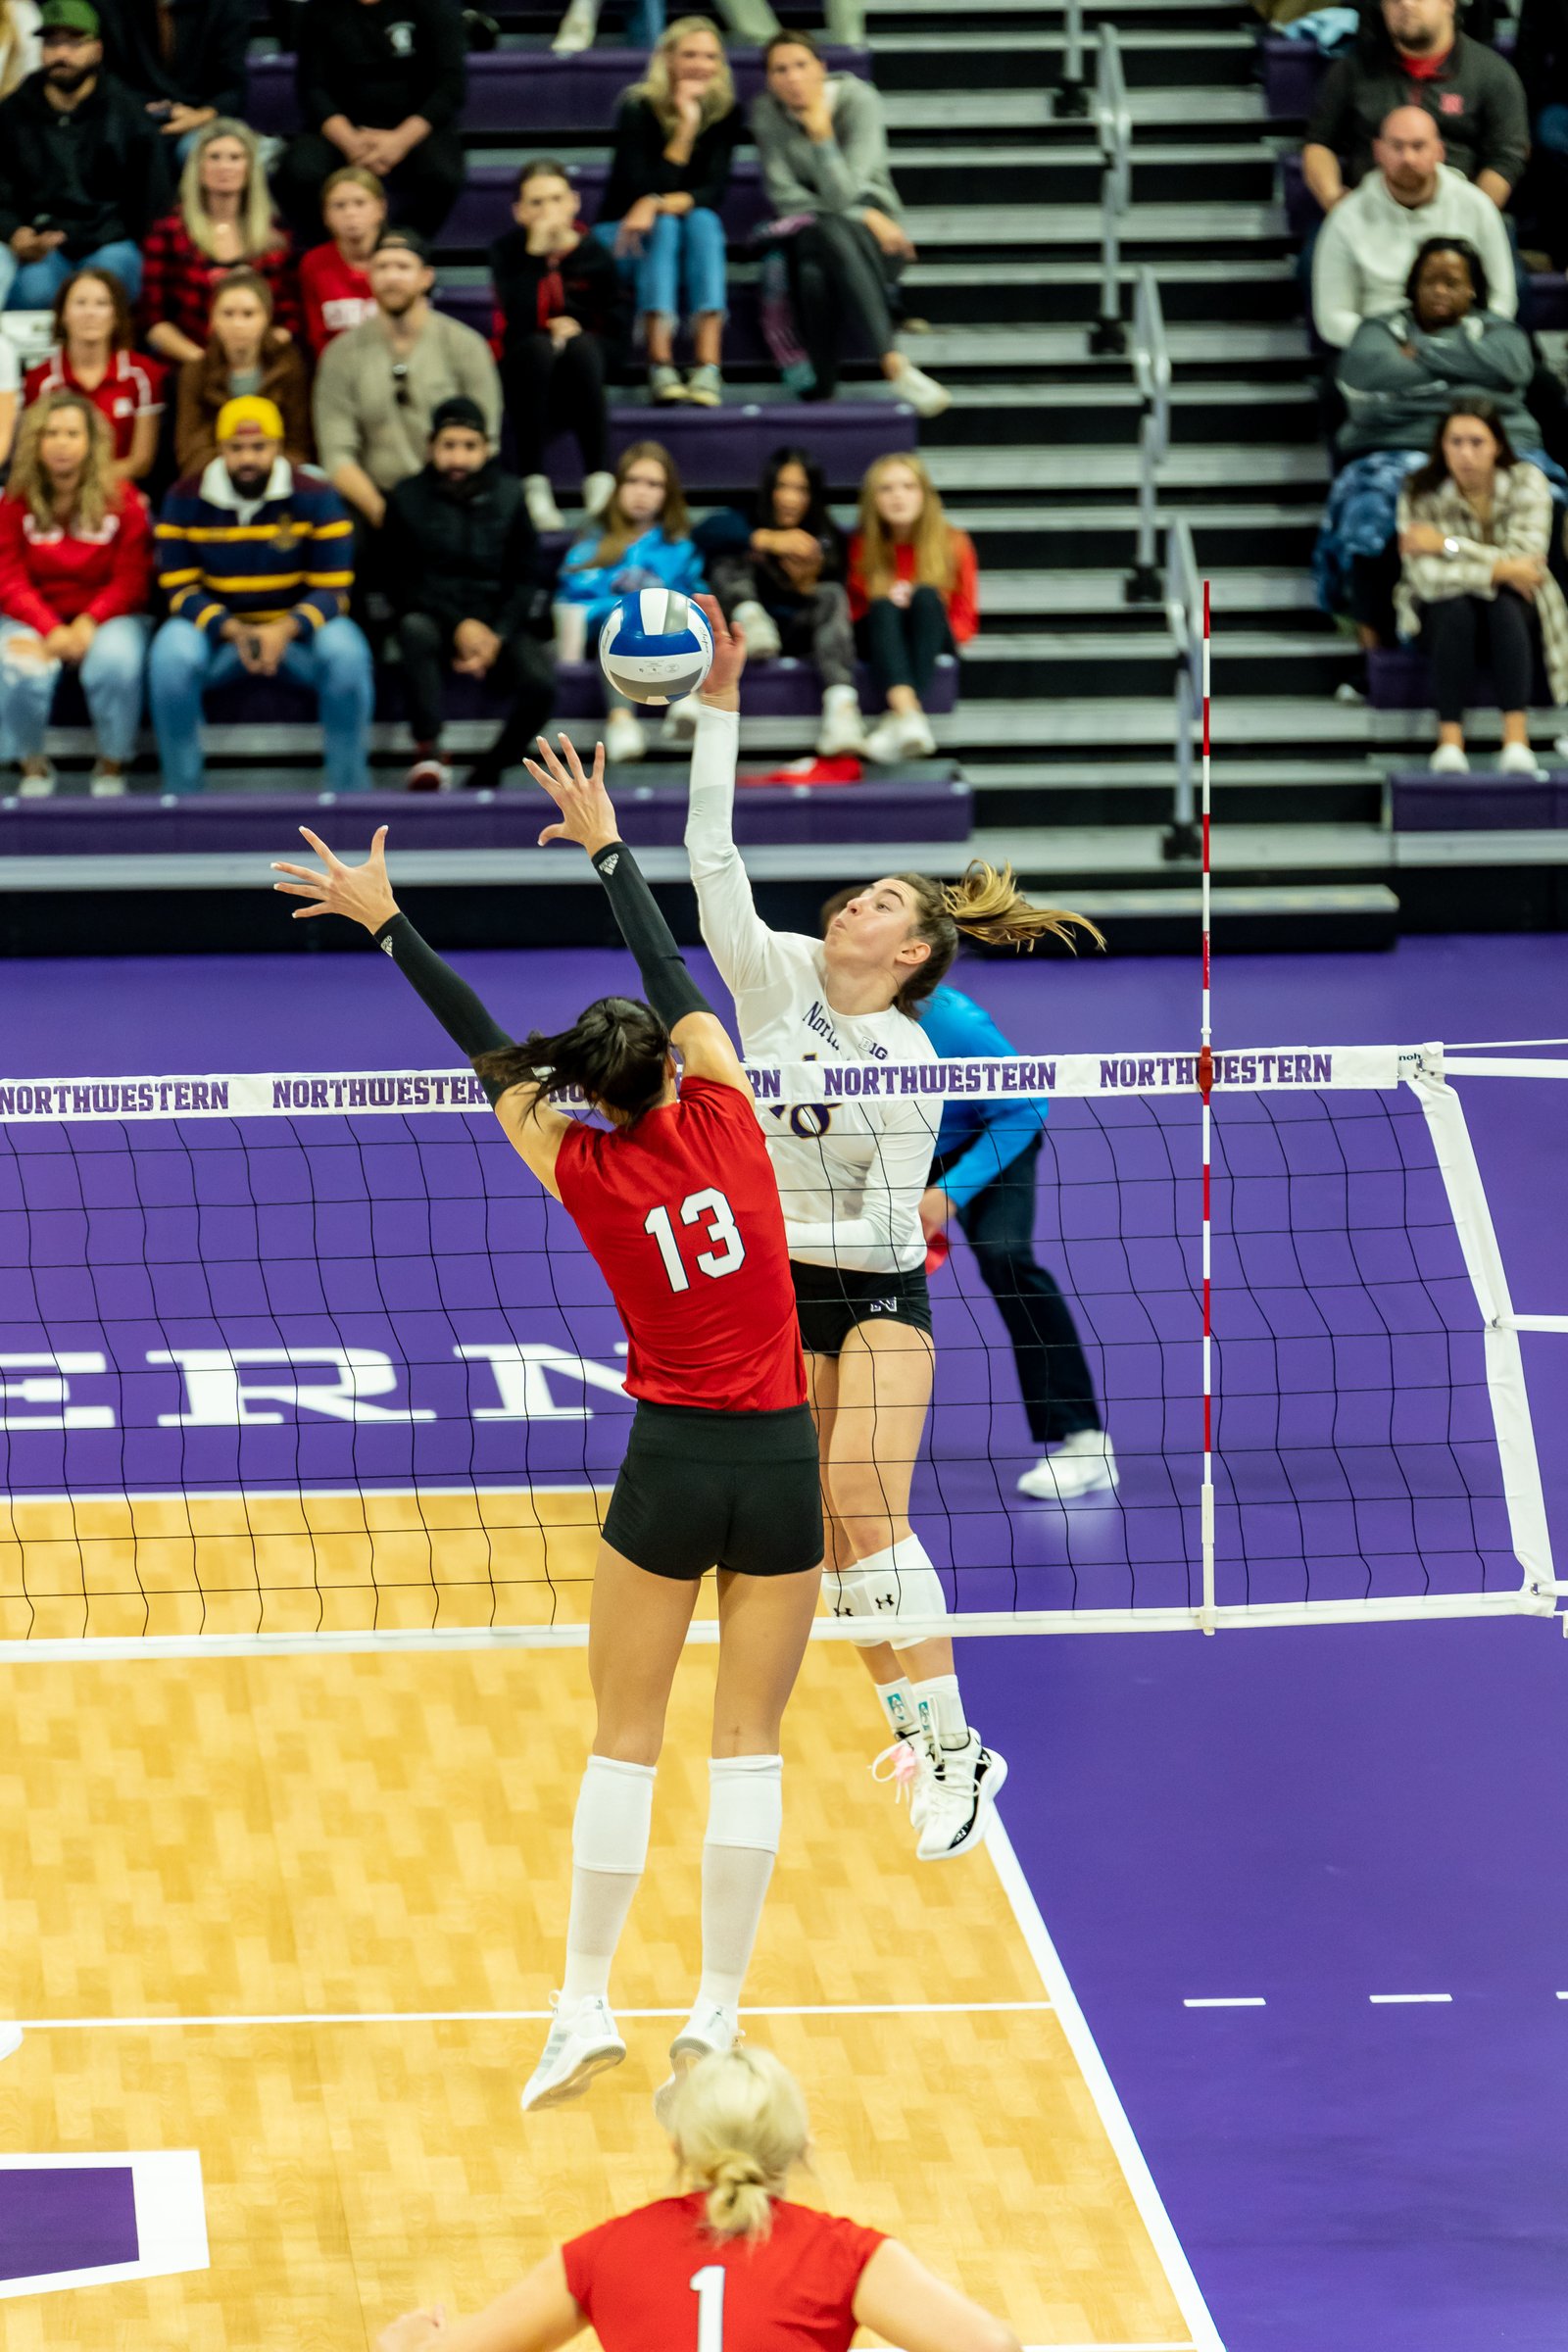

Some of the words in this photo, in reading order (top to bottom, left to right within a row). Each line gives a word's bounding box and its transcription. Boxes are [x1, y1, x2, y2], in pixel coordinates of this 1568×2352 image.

[0, 1081, 229, 1115] NORTHWESTERN
[272, 1075, 490, 1108] NORTHWESTER
[823, 1061, 1056, 1097] NORTHWESTERN
[644, 1186, 747, 1295] 13
[689, 2264, 726, 2352] 1
